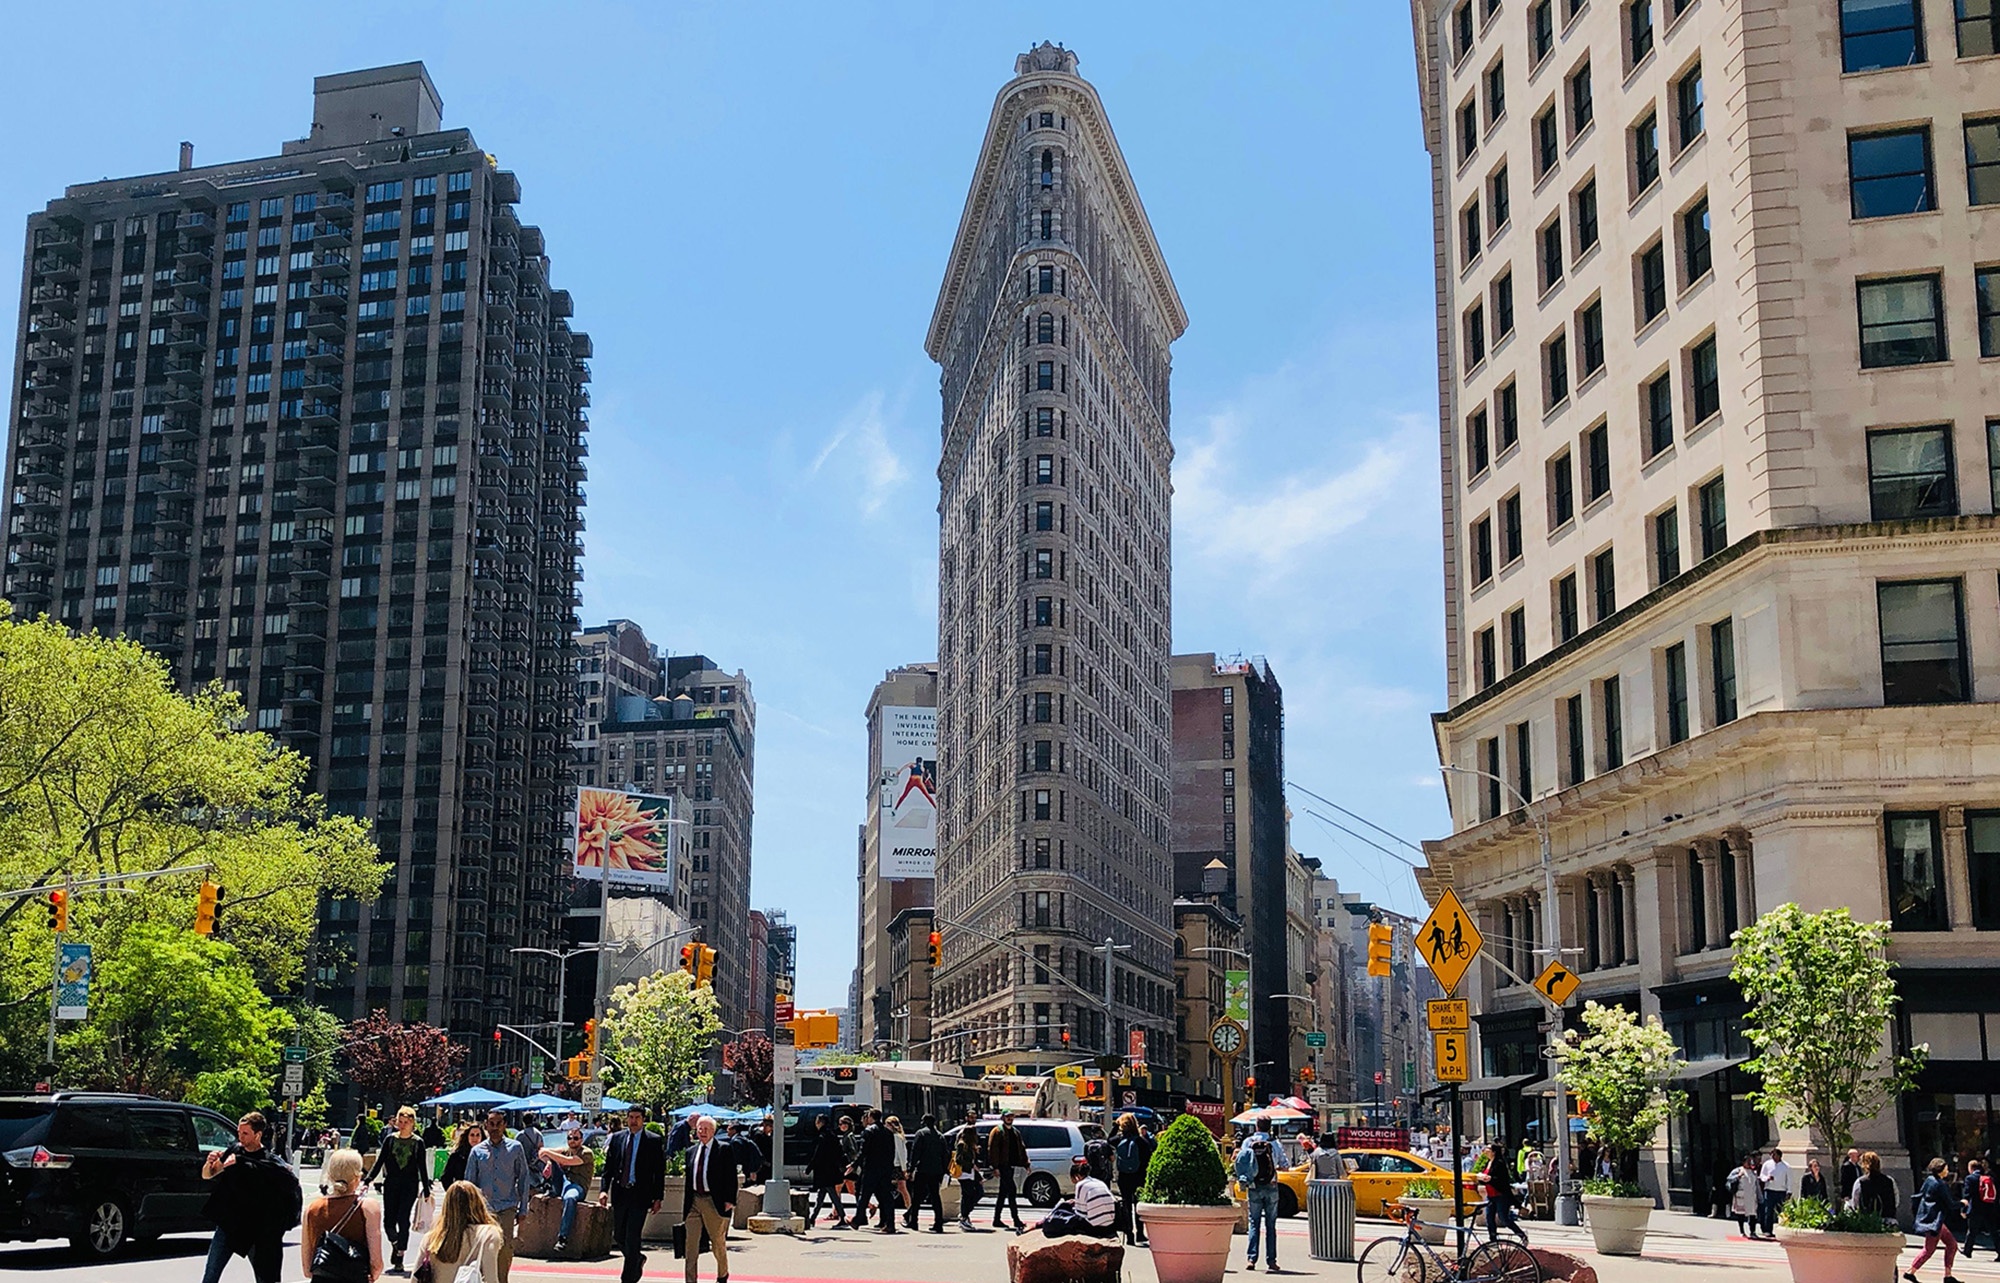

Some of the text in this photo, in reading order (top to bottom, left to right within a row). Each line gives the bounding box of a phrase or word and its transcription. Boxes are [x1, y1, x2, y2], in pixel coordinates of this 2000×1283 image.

[892, 848, 936, 856] MIRROR
[1432, 1002, 1464, 1014] SHARE THE
[1441, 1016, 1456, 1025] ROAD
[1446, 1039, 1456, 1061] 5
